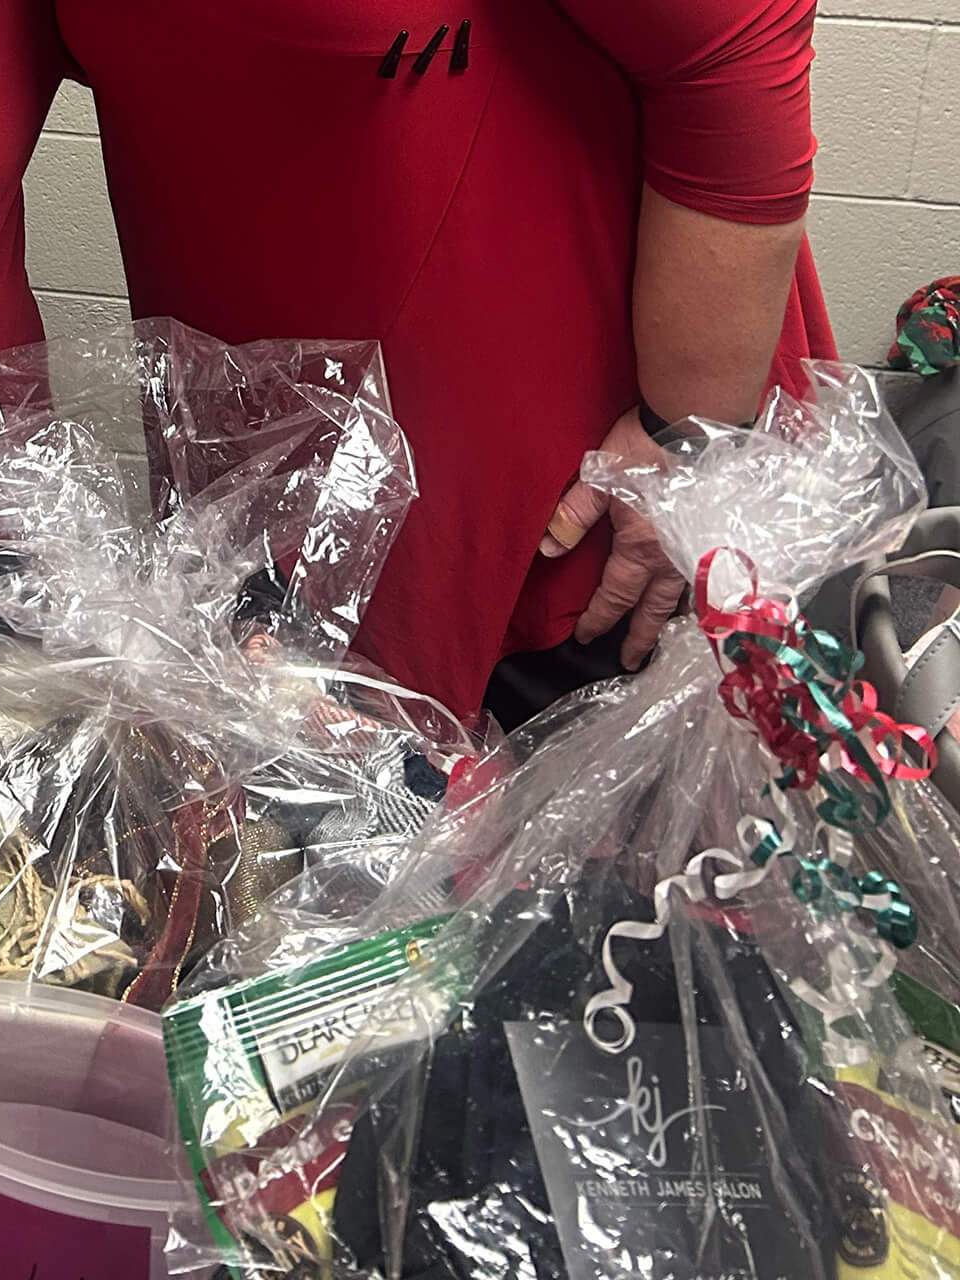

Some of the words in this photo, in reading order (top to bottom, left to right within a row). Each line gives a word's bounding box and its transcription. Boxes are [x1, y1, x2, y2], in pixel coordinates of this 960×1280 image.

[575, 1180, 650, 1197] KENNETH
[657, 1181, 704, 1198] JAMES
[712, 1182, 762, 1199] SALON
